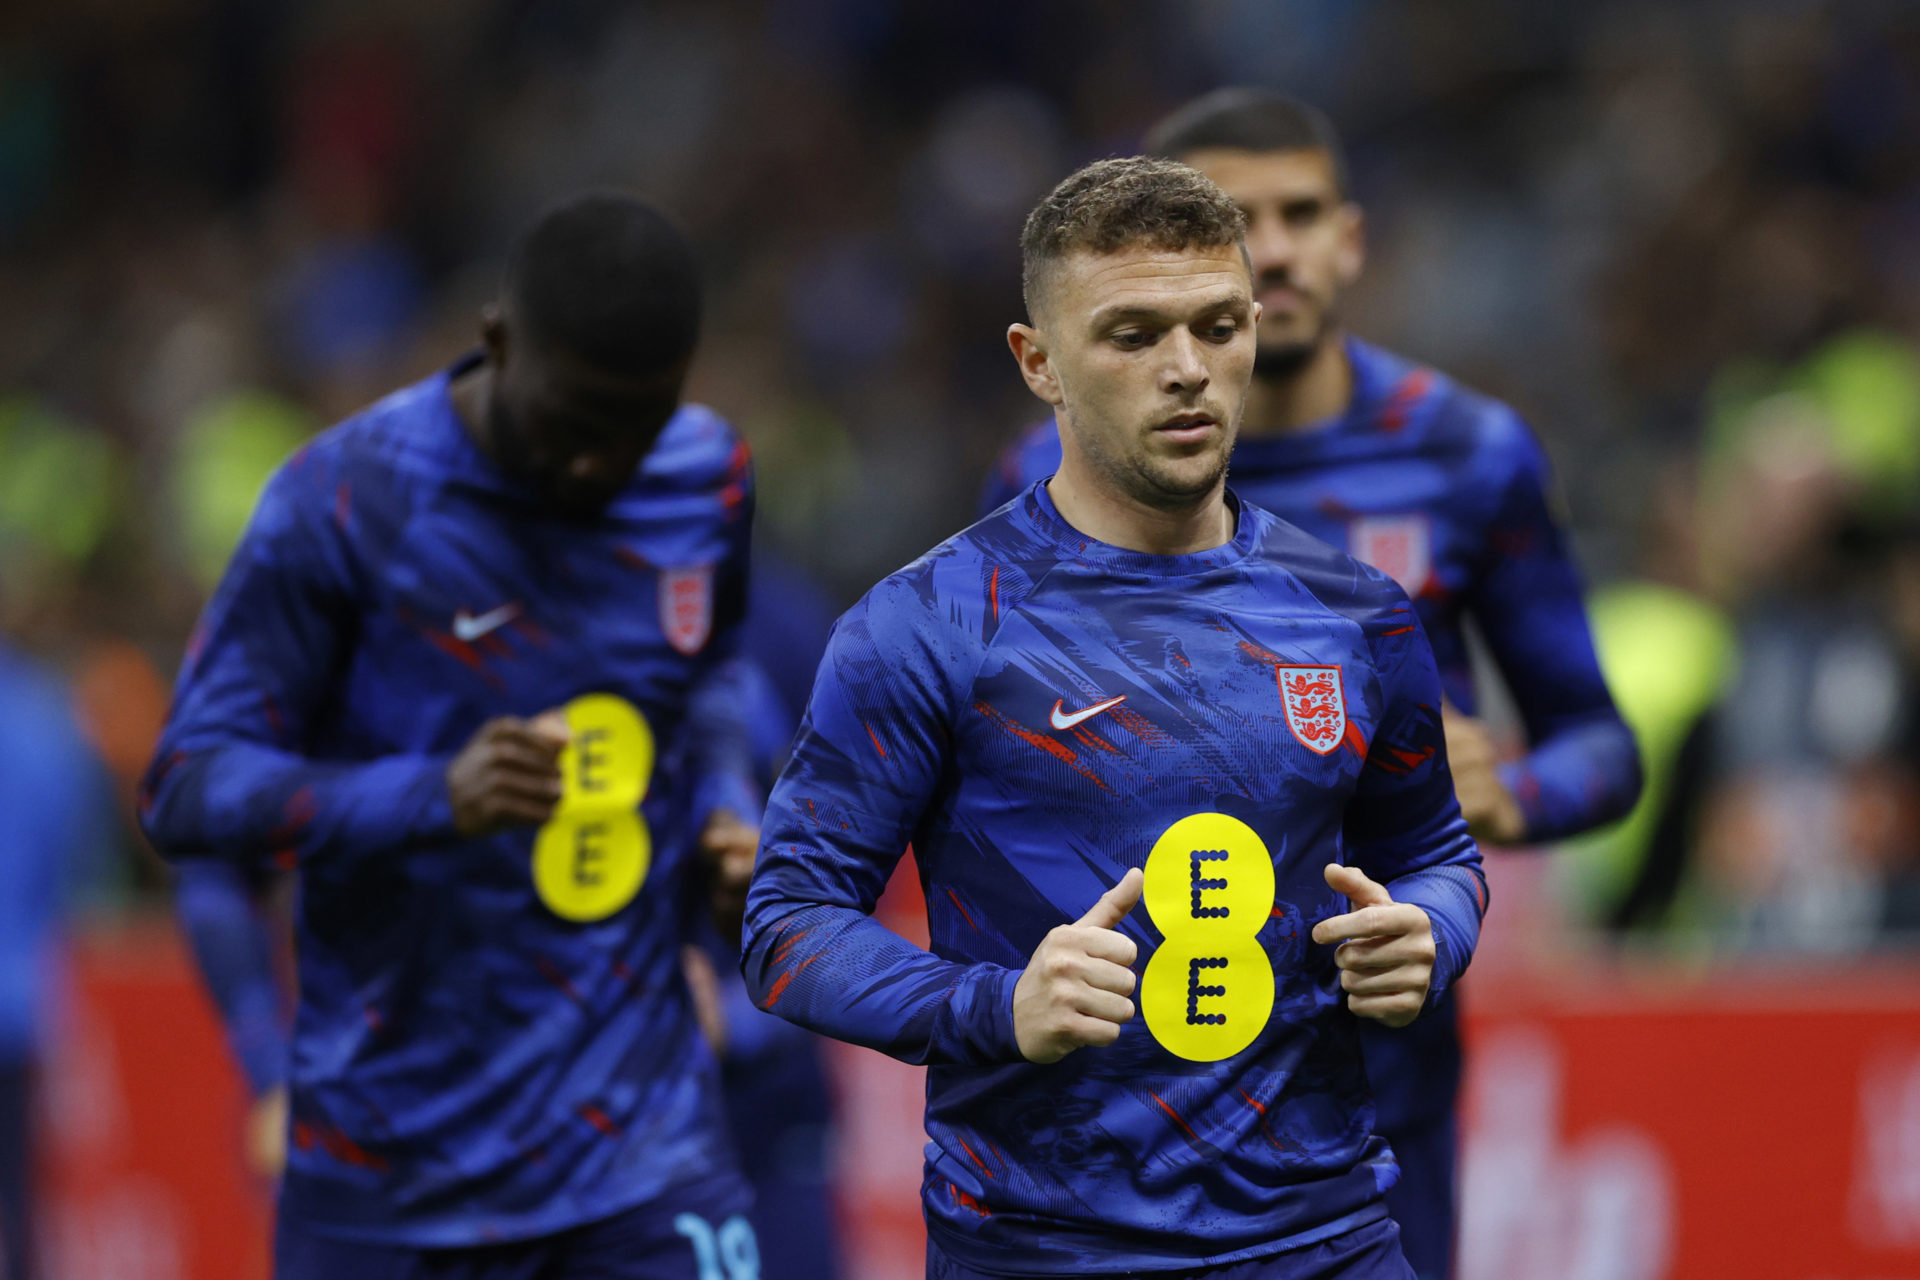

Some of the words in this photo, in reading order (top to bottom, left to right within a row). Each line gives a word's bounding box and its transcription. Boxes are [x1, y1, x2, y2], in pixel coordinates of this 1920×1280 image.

[572, 822, 612, 888] E
[1190, 850, 1230, 919] E
[1186, 957, 1227, 1025] E
